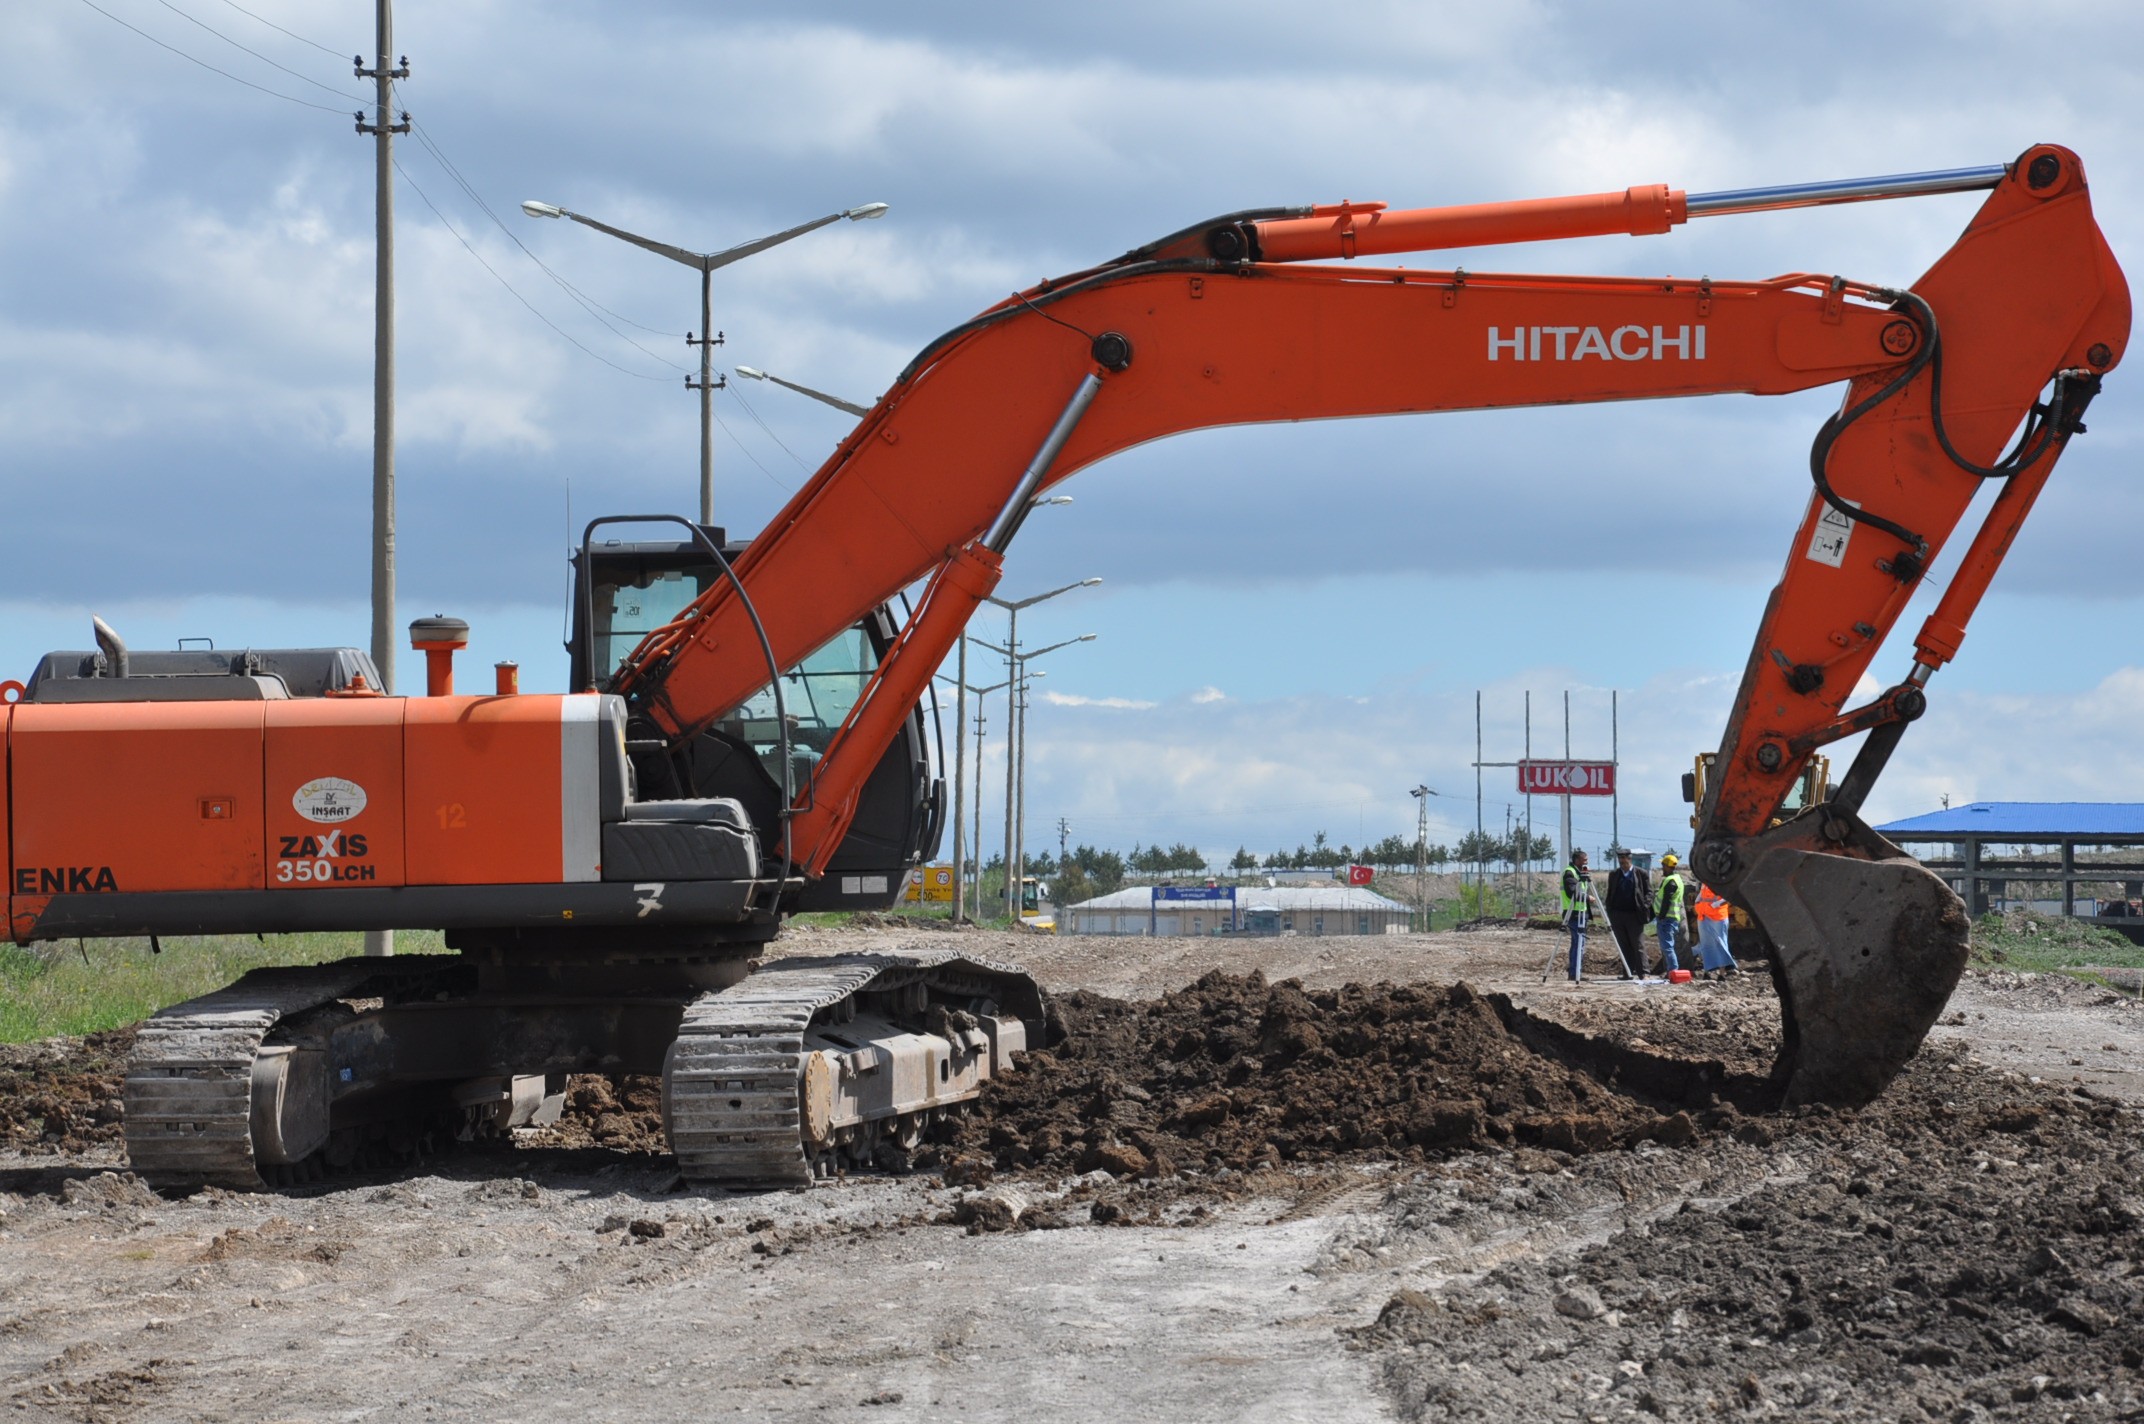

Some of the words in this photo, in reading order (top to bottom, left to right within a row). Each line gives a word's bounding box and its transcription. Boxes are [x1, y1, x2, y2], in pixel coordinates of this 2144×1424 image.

[1488, 325, 1706, 361] HITACHI
[312, 805, 351, 818] İNŞAAT
[436, 803, 466, 829] 12
[280, 829, 368, 858] ZAXIS
[17, 866, 118, 893] ENKA
[276, 860, 375, 882] 350LCH
